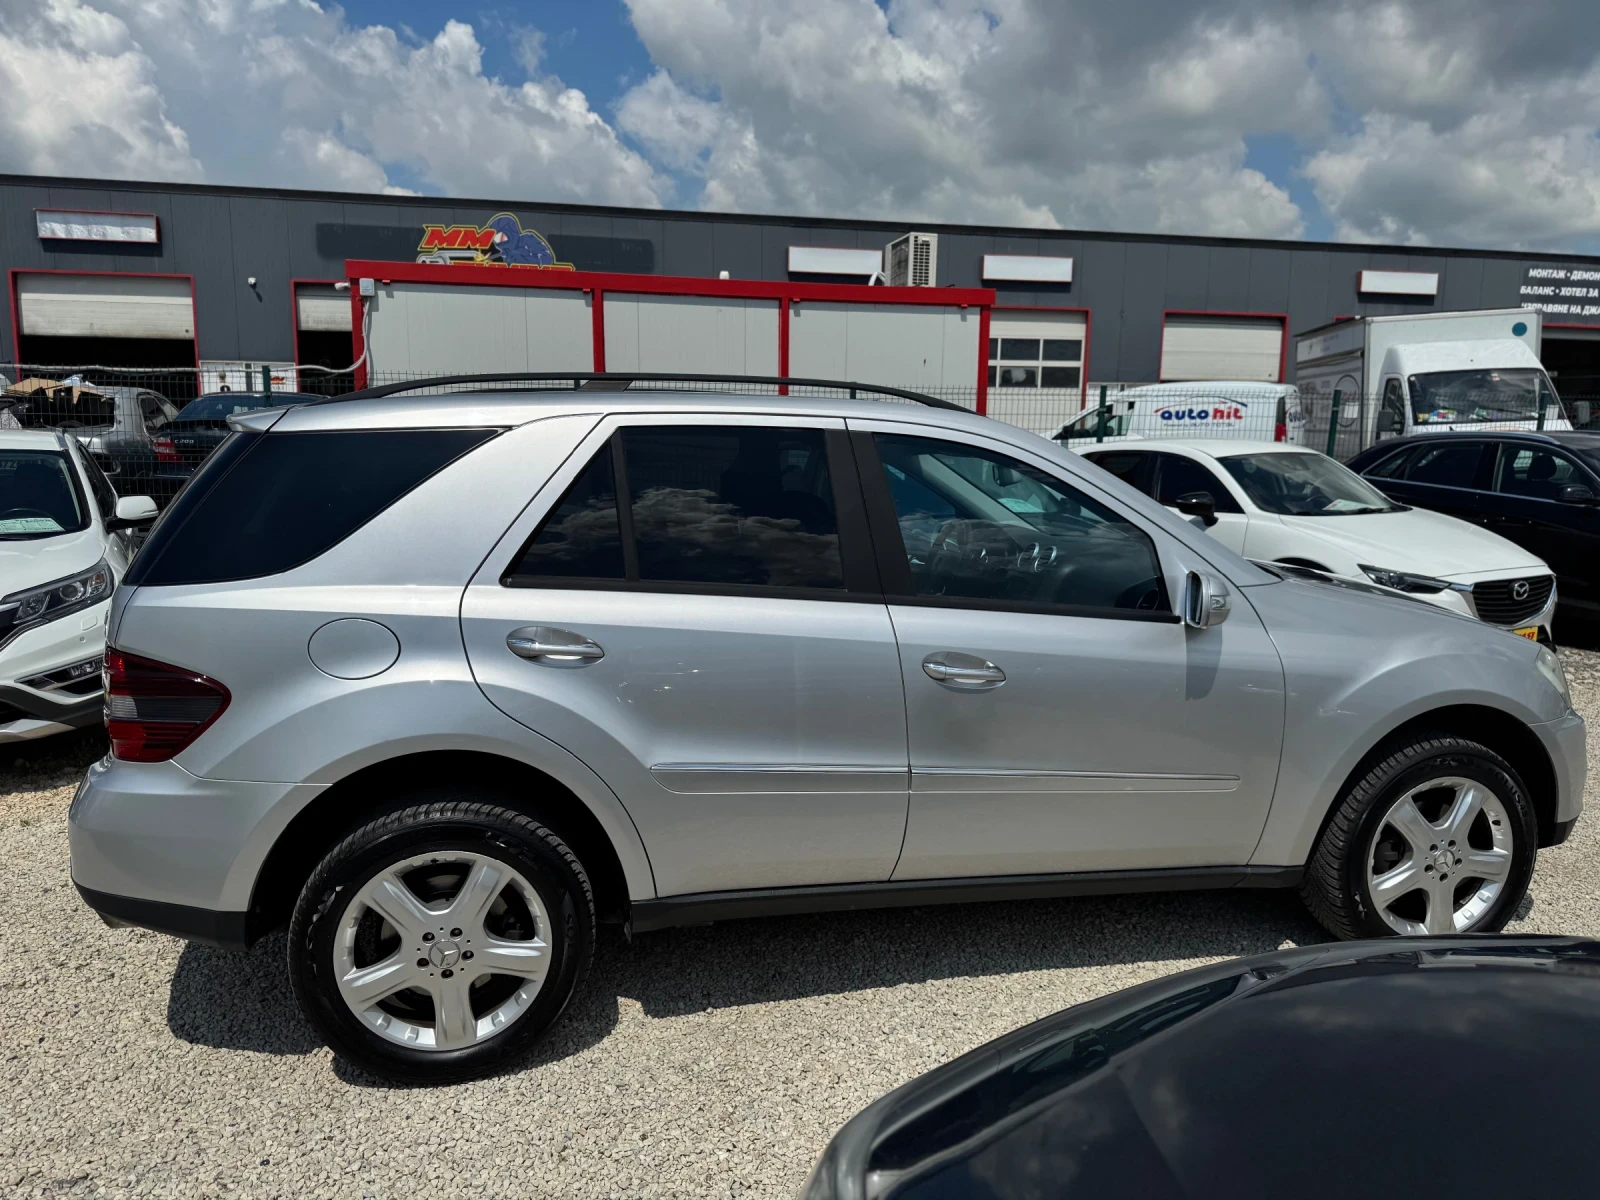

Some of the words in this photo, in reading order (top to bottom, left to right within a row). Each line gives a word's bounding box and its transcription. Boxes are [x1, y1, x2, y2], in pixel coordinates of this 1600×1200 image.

[423, 228, 496, 248] MM
[1528, 268, 1566, 279] МОНТАЖ
[1520, 285, 1554, 295] БАЛАНС
[1559, 287, 1587, 297] ХОТЕЛ
[1587, 288, 1599, 298] ЗА
[1569, 304, 1581, 314] НА
[1160, 408, 1209, 420] auto
[1212, 406, 1243, 420] hit
